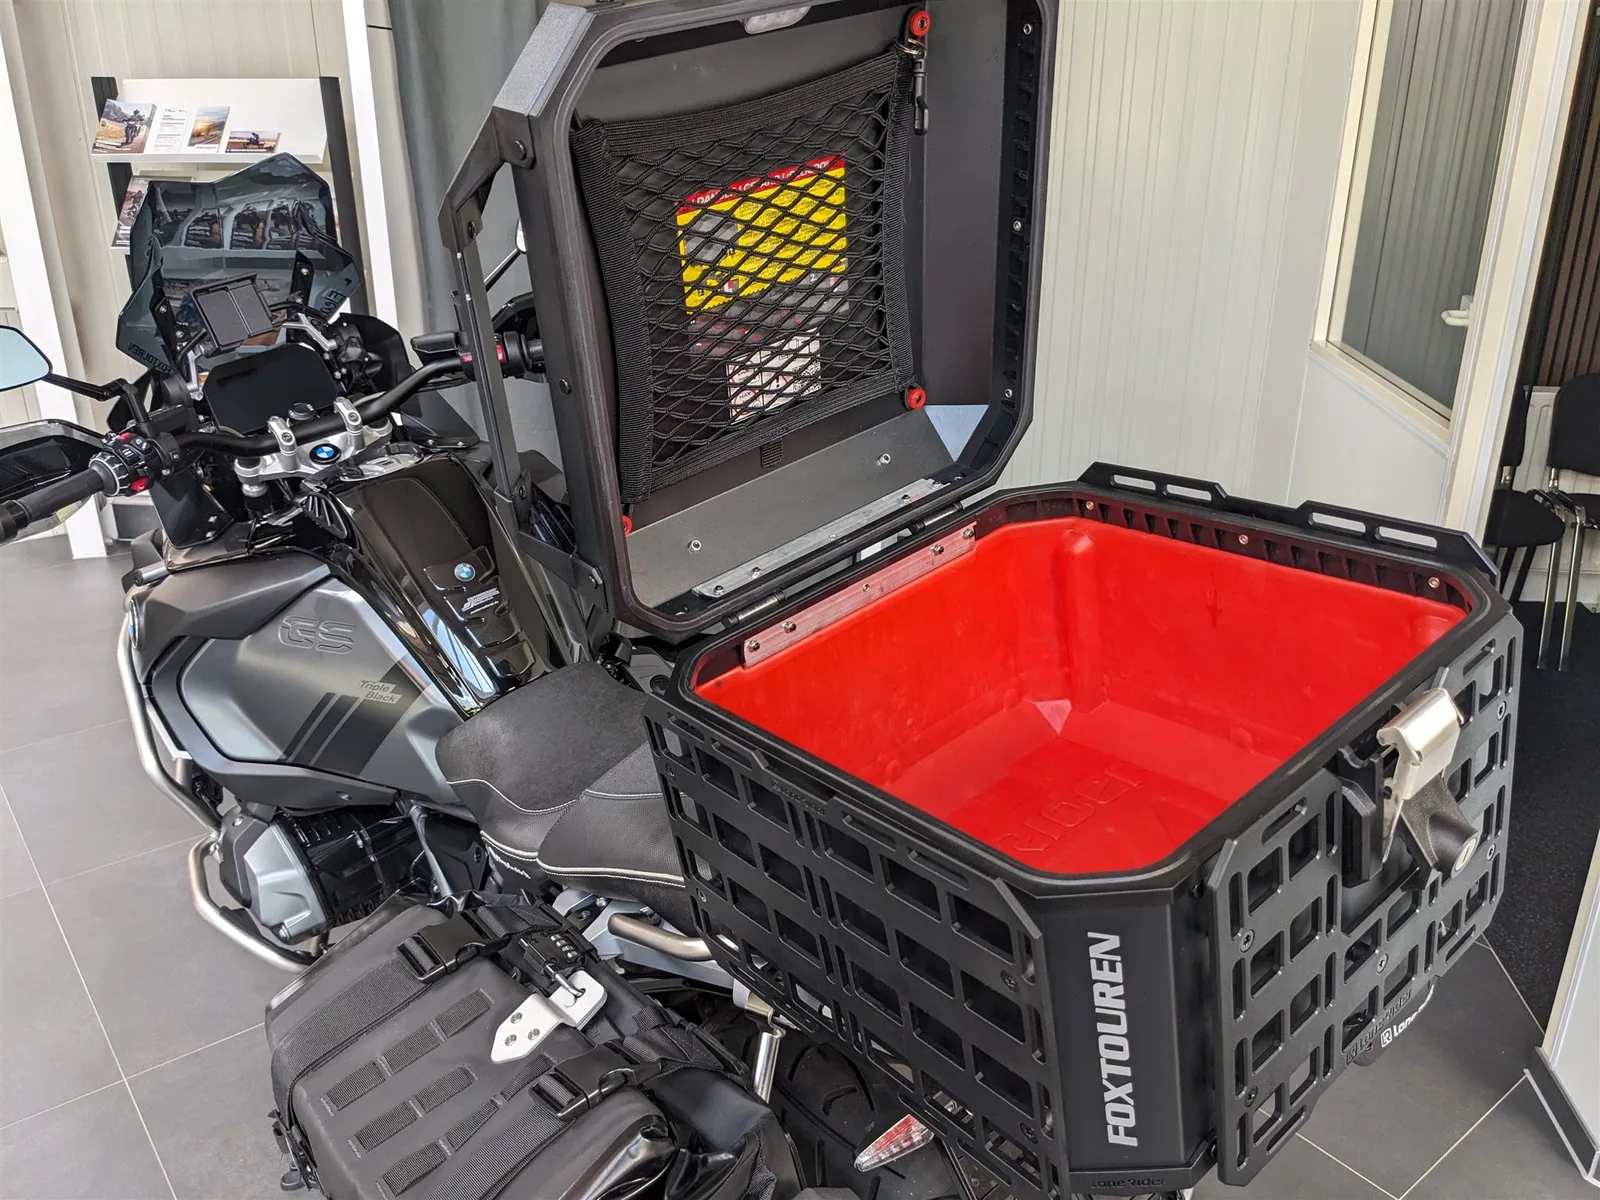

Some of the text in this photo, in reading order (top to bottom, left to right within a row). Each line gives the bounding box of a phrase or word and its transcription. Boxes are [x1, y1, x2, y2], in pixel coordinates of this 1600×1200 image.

[278, 615, 356, 655] GS
[360, 680, 390, 693] Triple
[365, 690, 397, 703] Black
[1087, 931, 1138, 1147] FOXTOUREN
